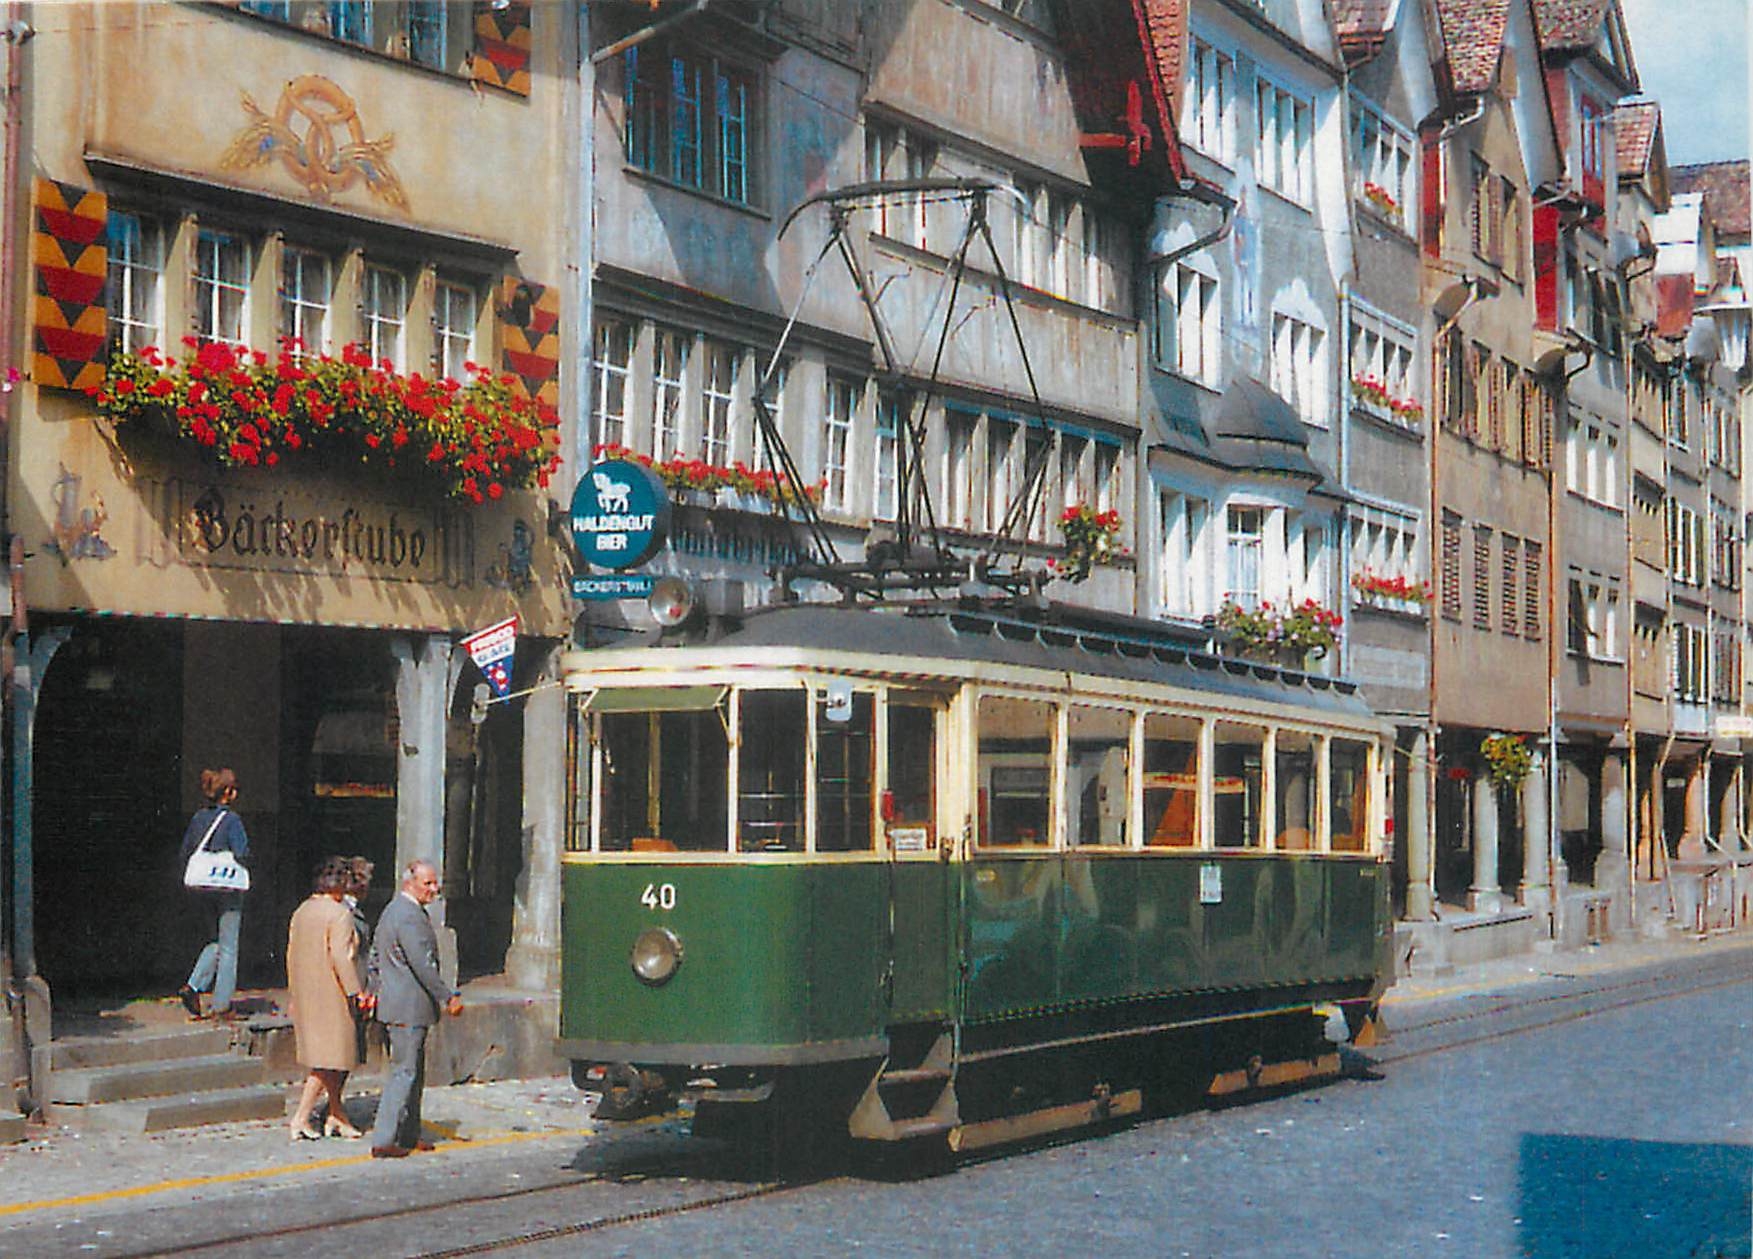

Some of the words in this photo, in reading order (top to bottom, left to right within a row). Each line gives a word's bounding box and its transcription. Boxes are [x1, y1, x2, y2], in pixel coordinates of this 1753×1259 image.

[573, 515, 654, 532] HALDENGUT
[596, 534, 628, 550] BIER
[641, 883, 676, 910] 40
